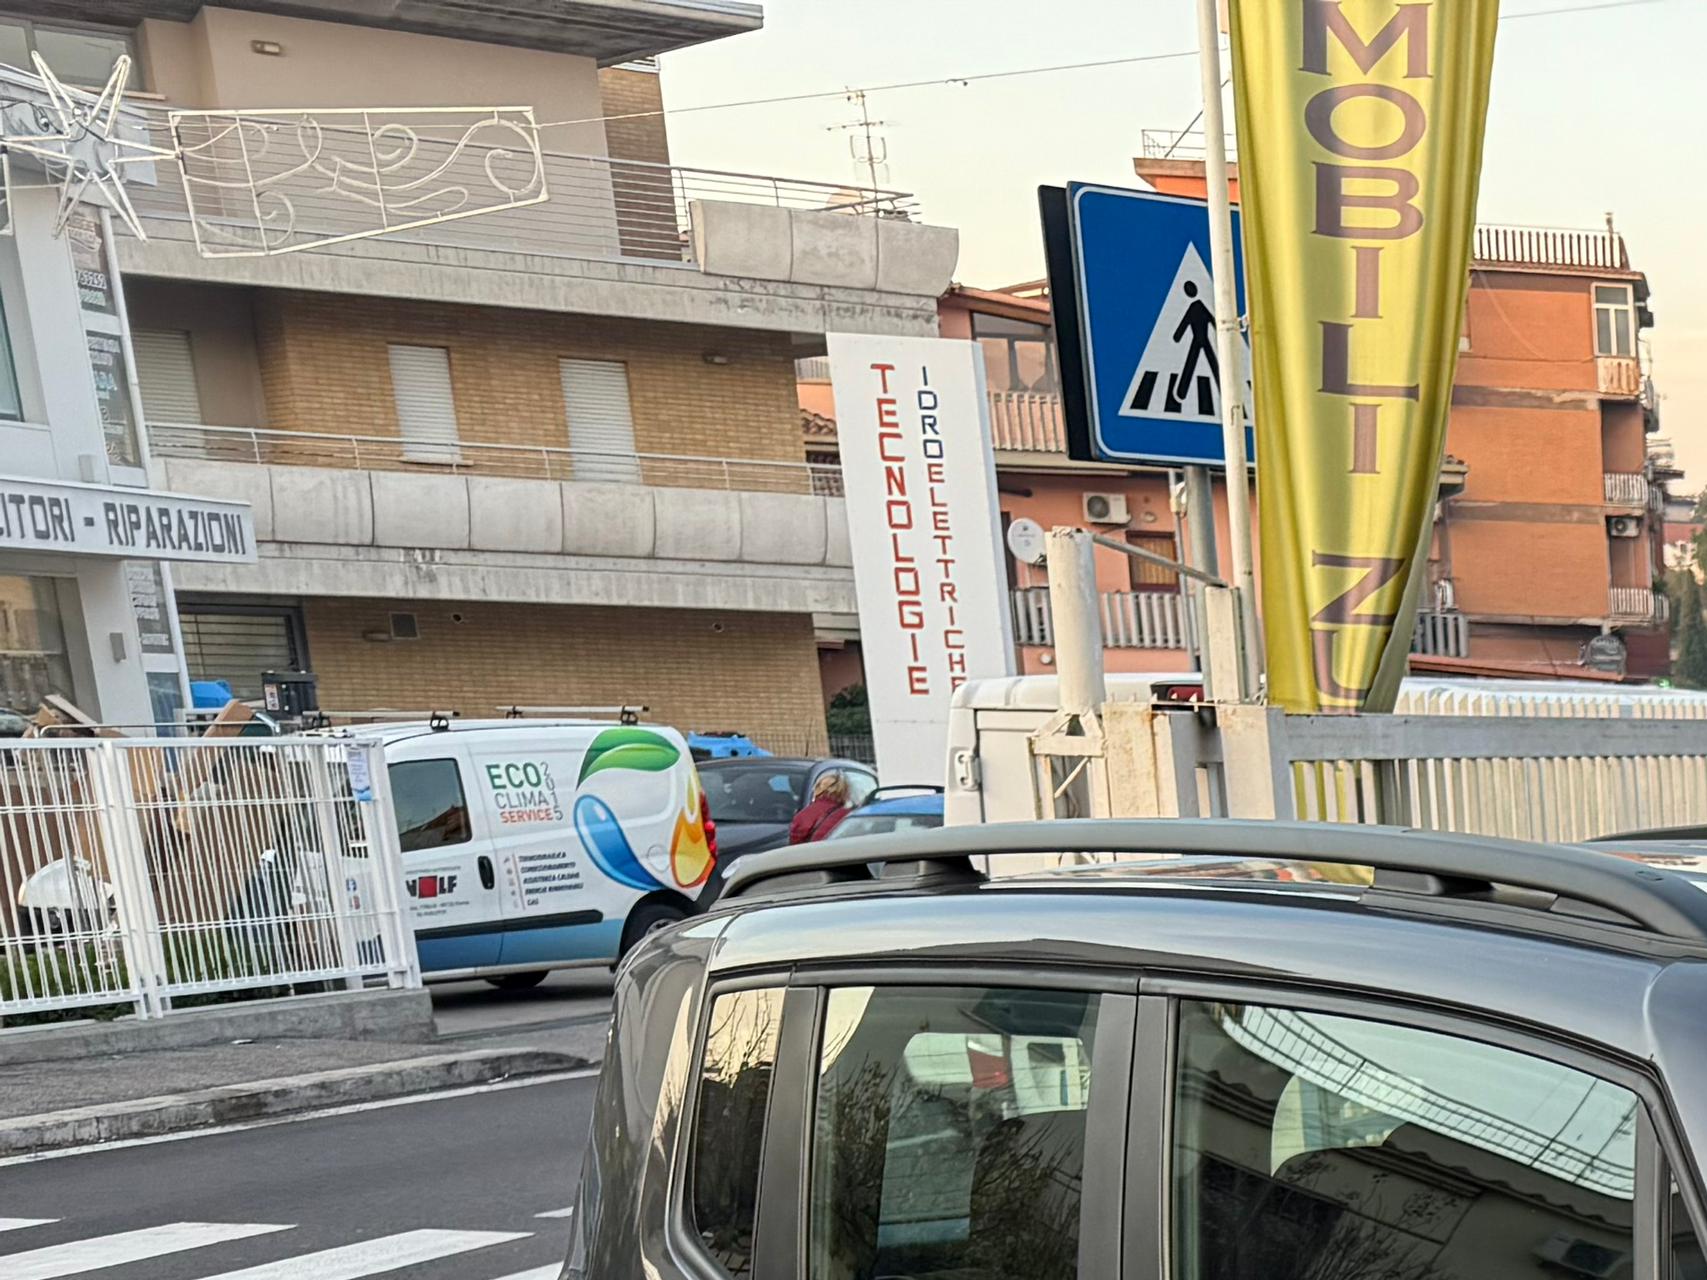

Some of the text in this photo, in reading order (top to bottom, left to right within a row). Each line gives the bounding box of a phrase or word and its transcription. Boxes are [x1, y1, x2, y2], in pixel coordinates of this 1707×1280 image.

[0, 493, 75, 542] ITORI
[103, 501, 247, 555] RIPARAZIONI
[870, 363, 930, 695] TECNOLOGIE
[917, 366, 968, 692] IDROELETTRICHE
[1310, 549, 1406, 716] ZU
[485, 762, 542, 790] ECO
[494, 790, 550, 809] CLIMA
[500, 808, 553, 824] SERVICE
